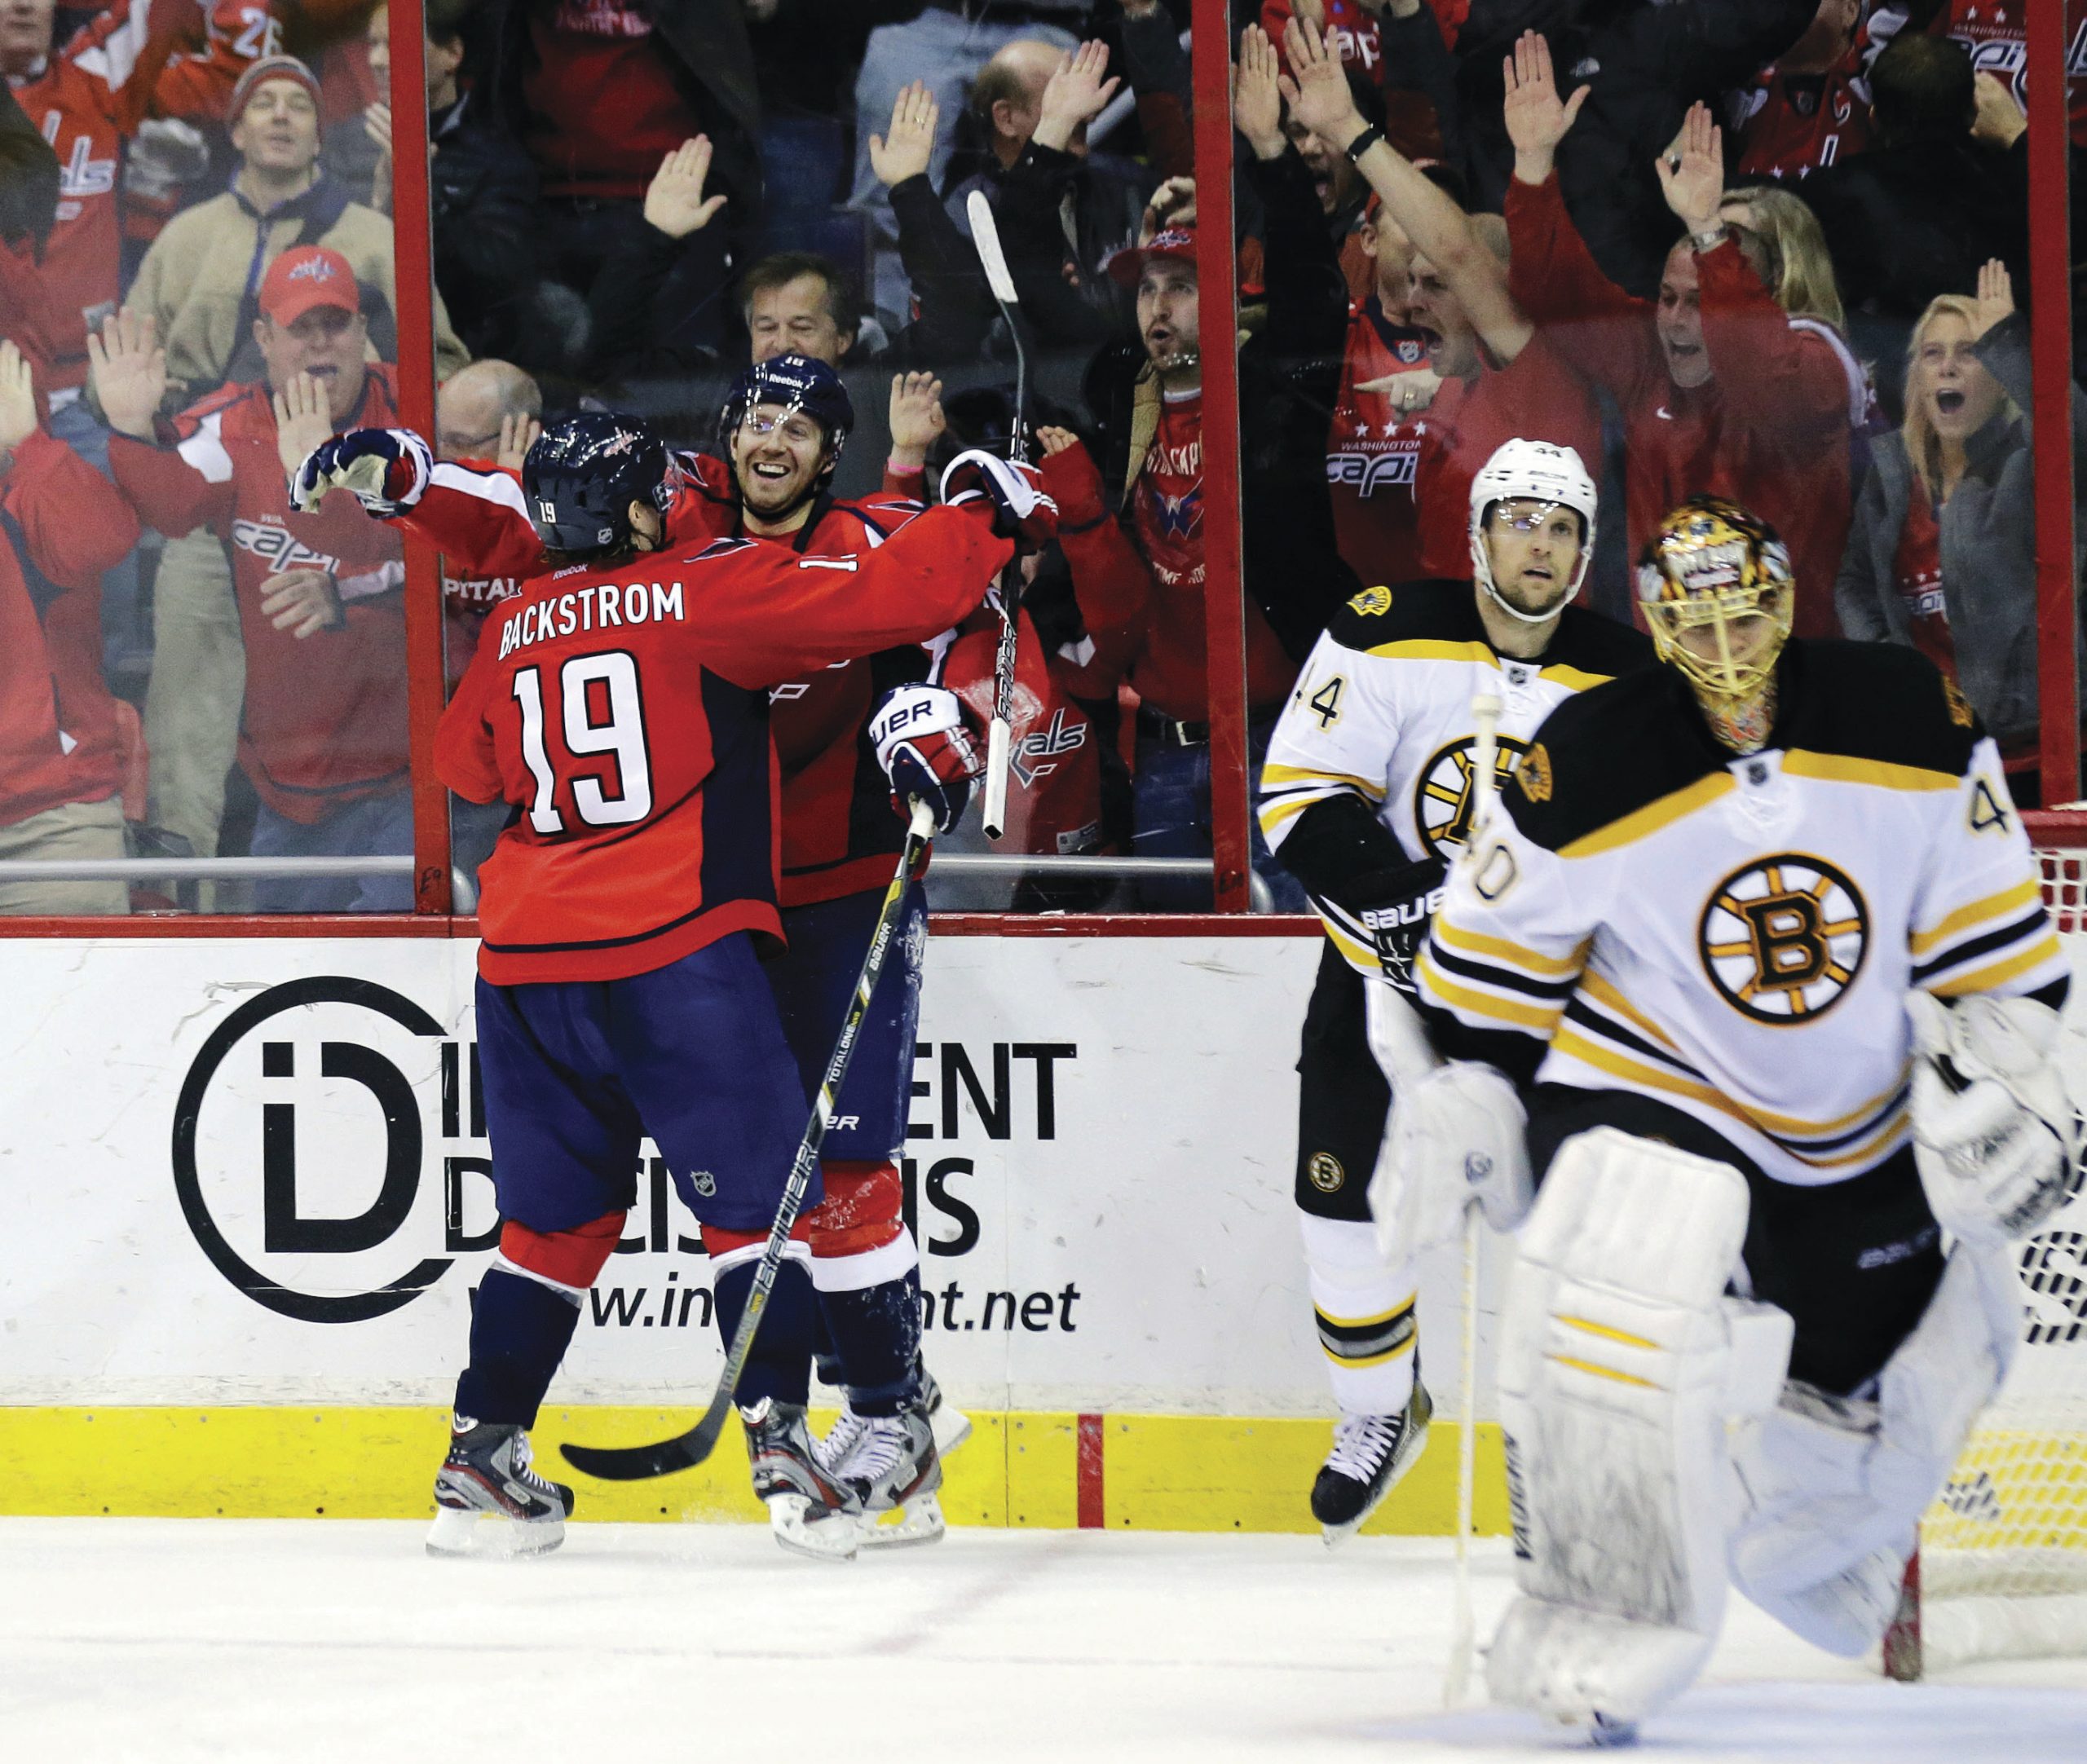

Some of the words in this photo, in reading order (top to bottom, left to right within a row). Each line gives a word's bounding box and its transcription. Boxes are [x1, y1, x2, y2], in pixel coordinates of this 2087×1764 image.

[769, 373, 804, 389] Reebok
[539, 502, 557, 523] 19
[498, 581, 685, 661] BACKSTROM
[513, 651, 651, 836] 19
